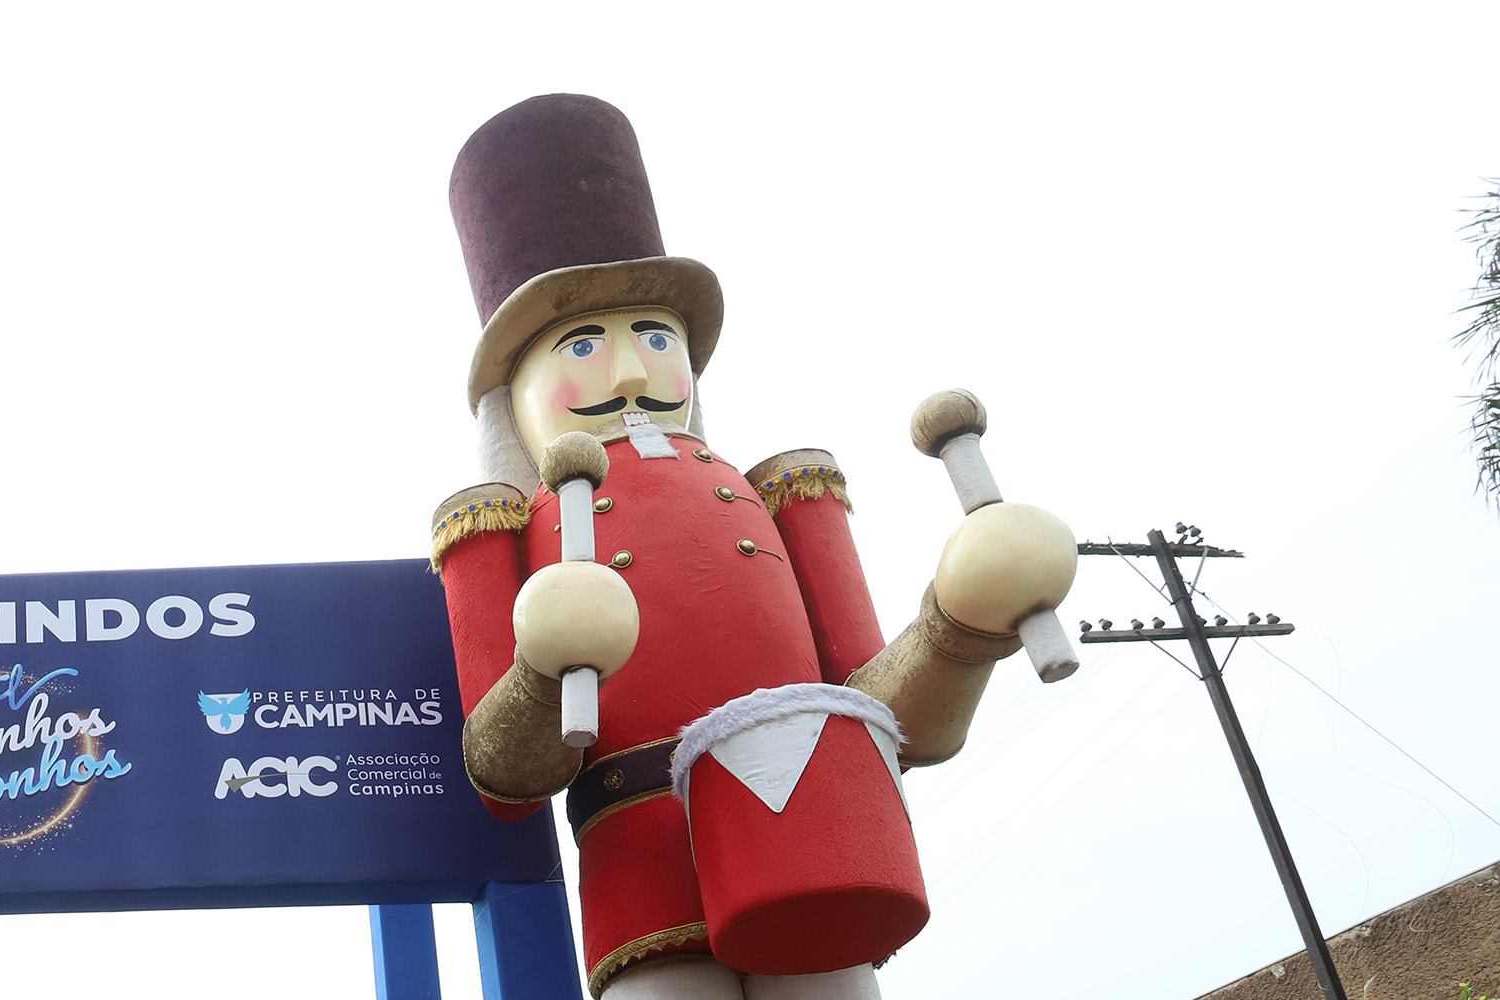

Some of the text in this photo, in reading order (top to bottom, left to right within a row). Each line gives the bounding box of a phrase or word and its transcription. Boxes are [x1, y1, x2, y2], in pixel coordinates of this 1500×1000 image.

[253, 688, 441, 703] PREFEITURA DE
[254, 701, 443, 728] CAMPINAS
[346, 752, 440, 767] Associação
[214, 755, 338, 799] ACIC
[348, 768, 442, 781] Comercial de
[349, 783, 444, 798] Campinas
